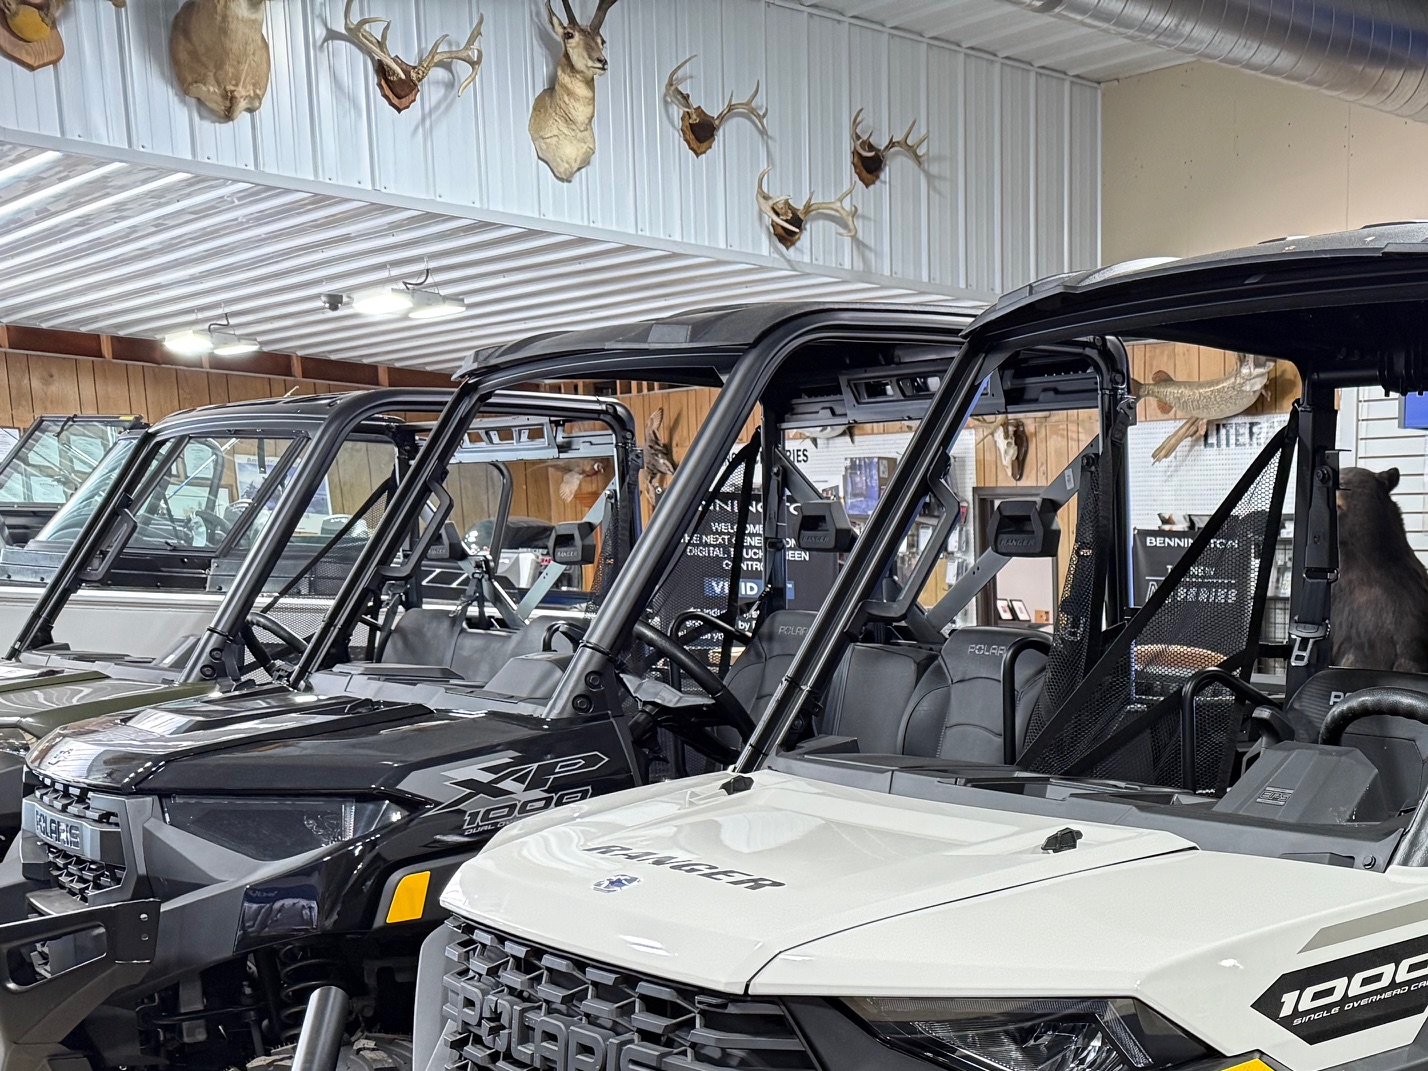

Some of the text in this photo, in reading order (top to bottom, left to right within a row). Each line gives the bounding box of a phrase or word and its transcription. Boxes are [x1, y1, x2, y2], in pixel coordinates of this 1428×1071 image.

[703, 535, 729, 545] NEXT
[1146, 536, 1238, 549] BENNINTON
[582, 845, 786, 891] RANGER
[1292, 1006, 1341, 1026] SINGLE
[1344, 985, 1409, 1011] OVERHEAD
